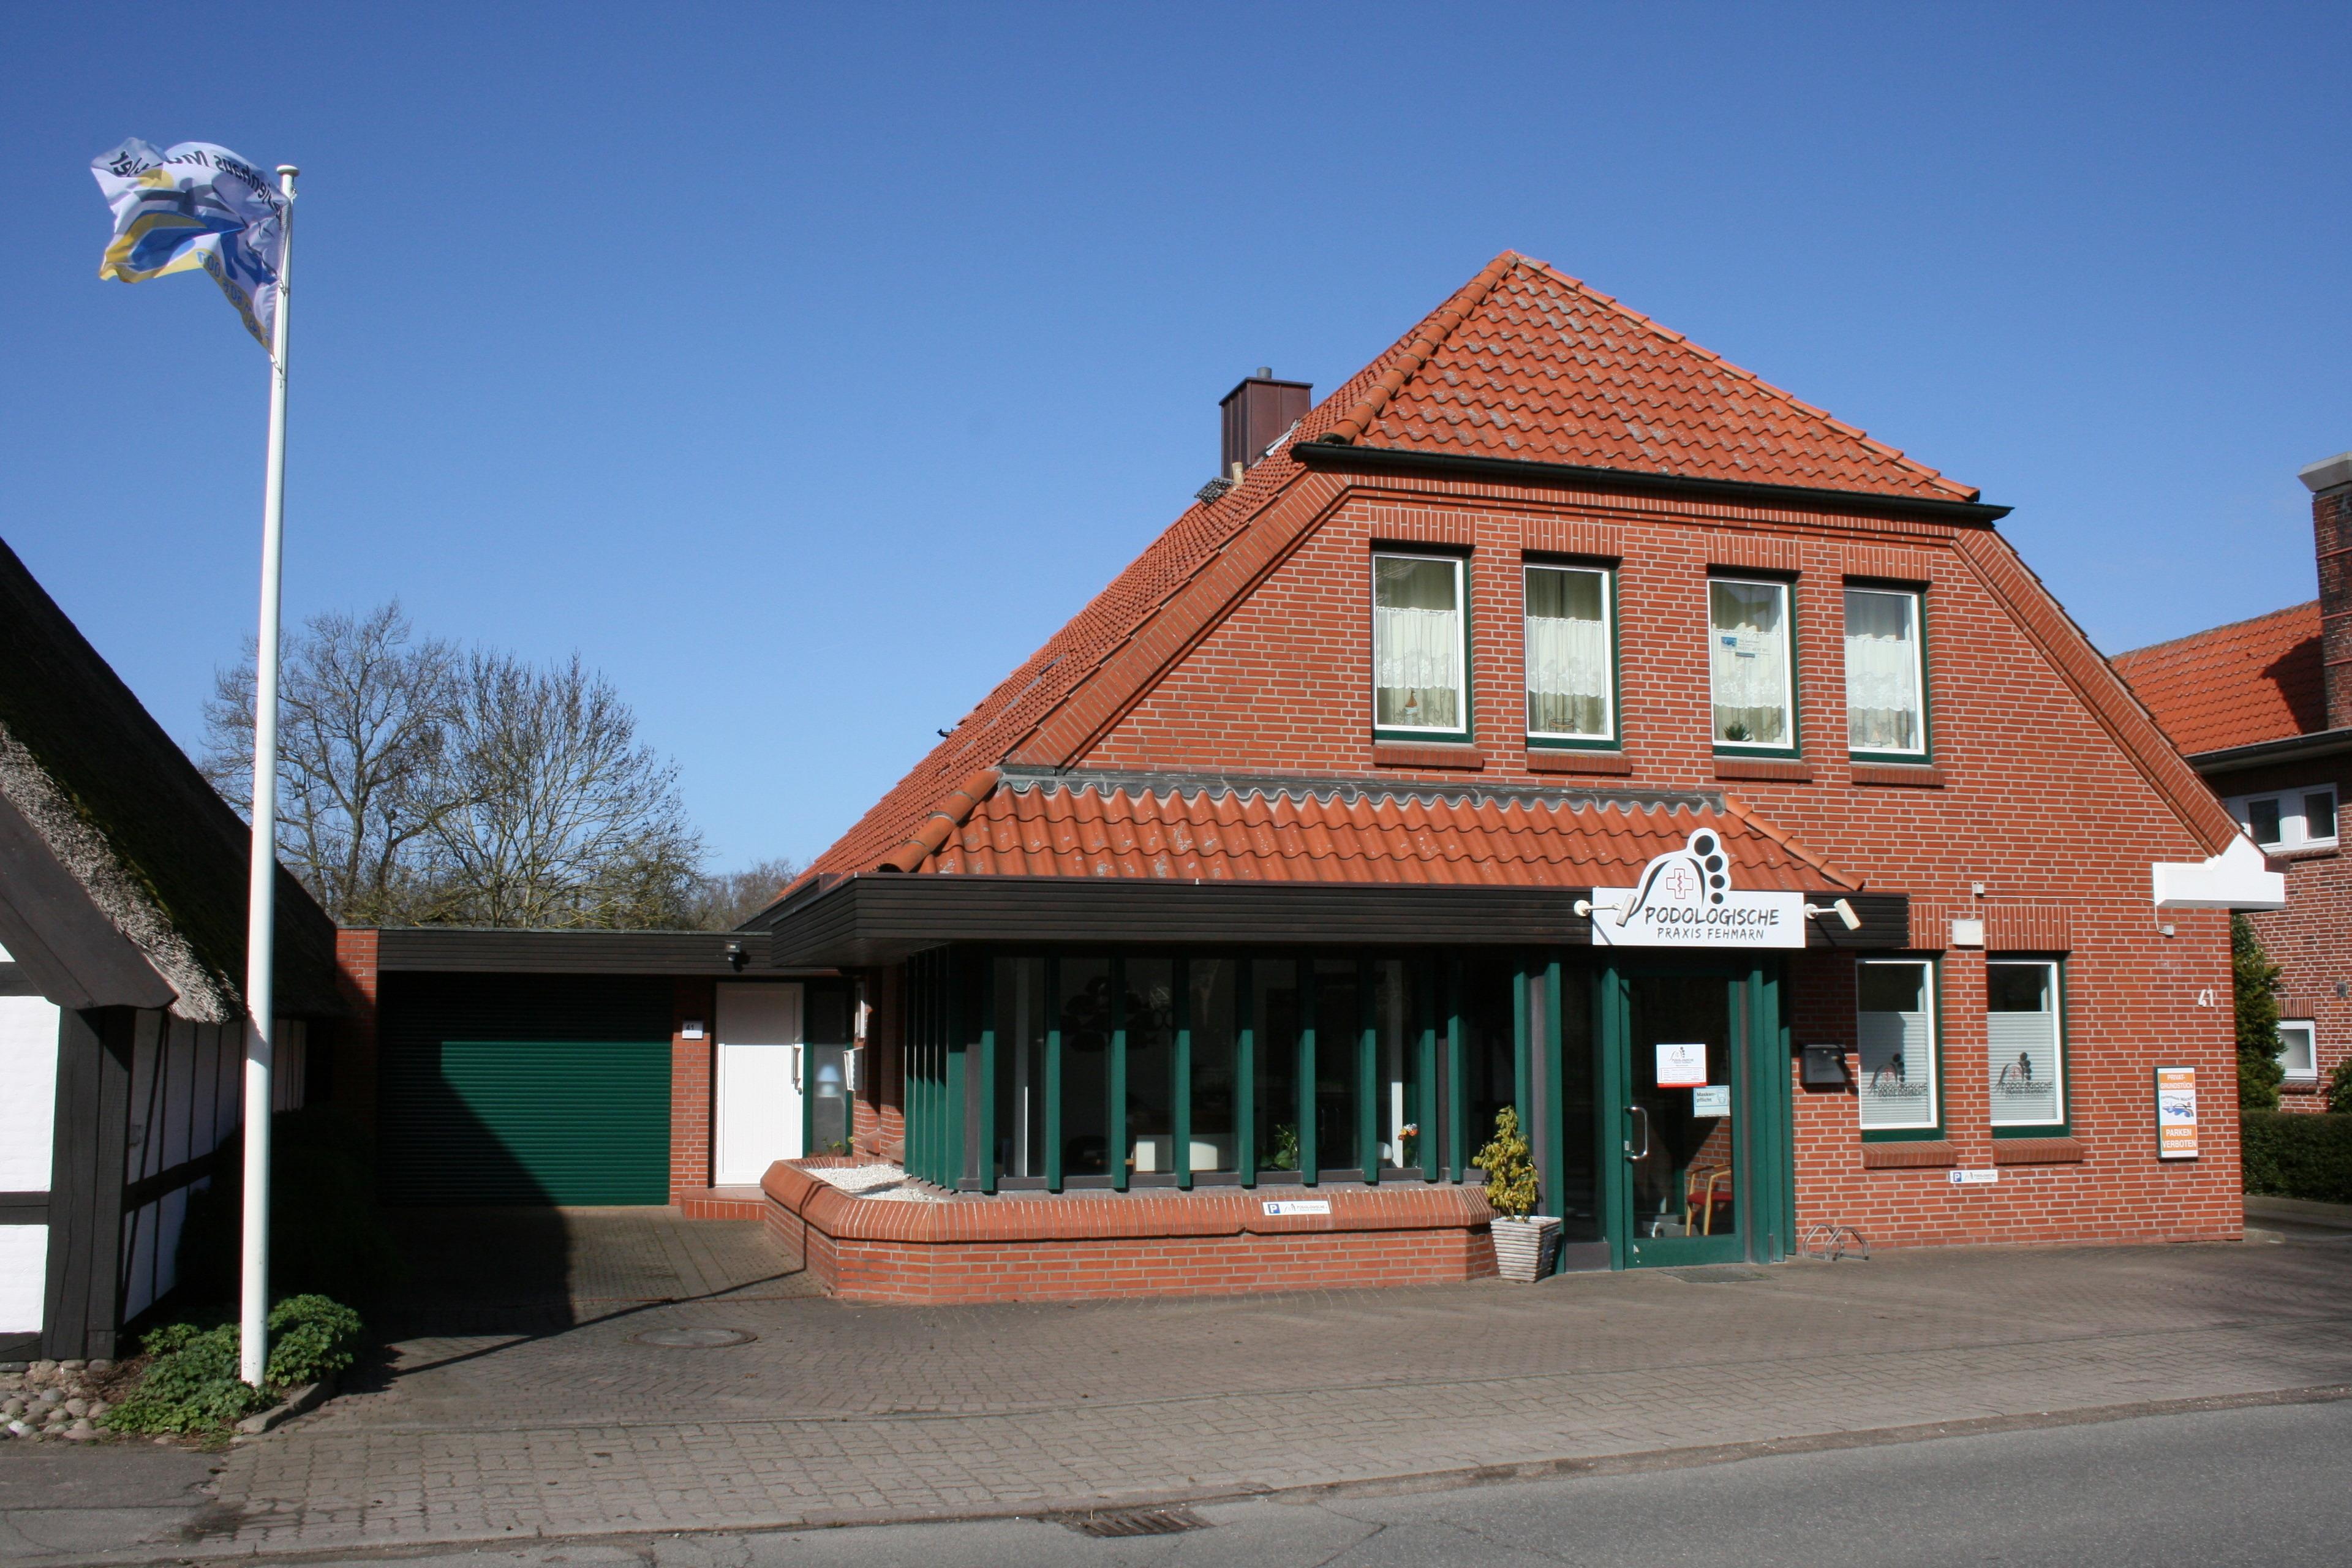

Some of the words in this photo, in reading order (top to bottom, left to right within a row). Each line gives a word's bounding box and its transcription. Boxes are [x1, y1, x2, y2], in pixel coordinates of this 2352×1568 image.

[1645, 906, 1780, 926] PODOLOGISCHE
[1657, 927, 1702, 940] PRAXIS
[1707, 928, 1765, 941] FEHMARN
[2198, 989, 2214, 1007] 41
[2162, 1139, 2196, 1148] VERBOTEN
